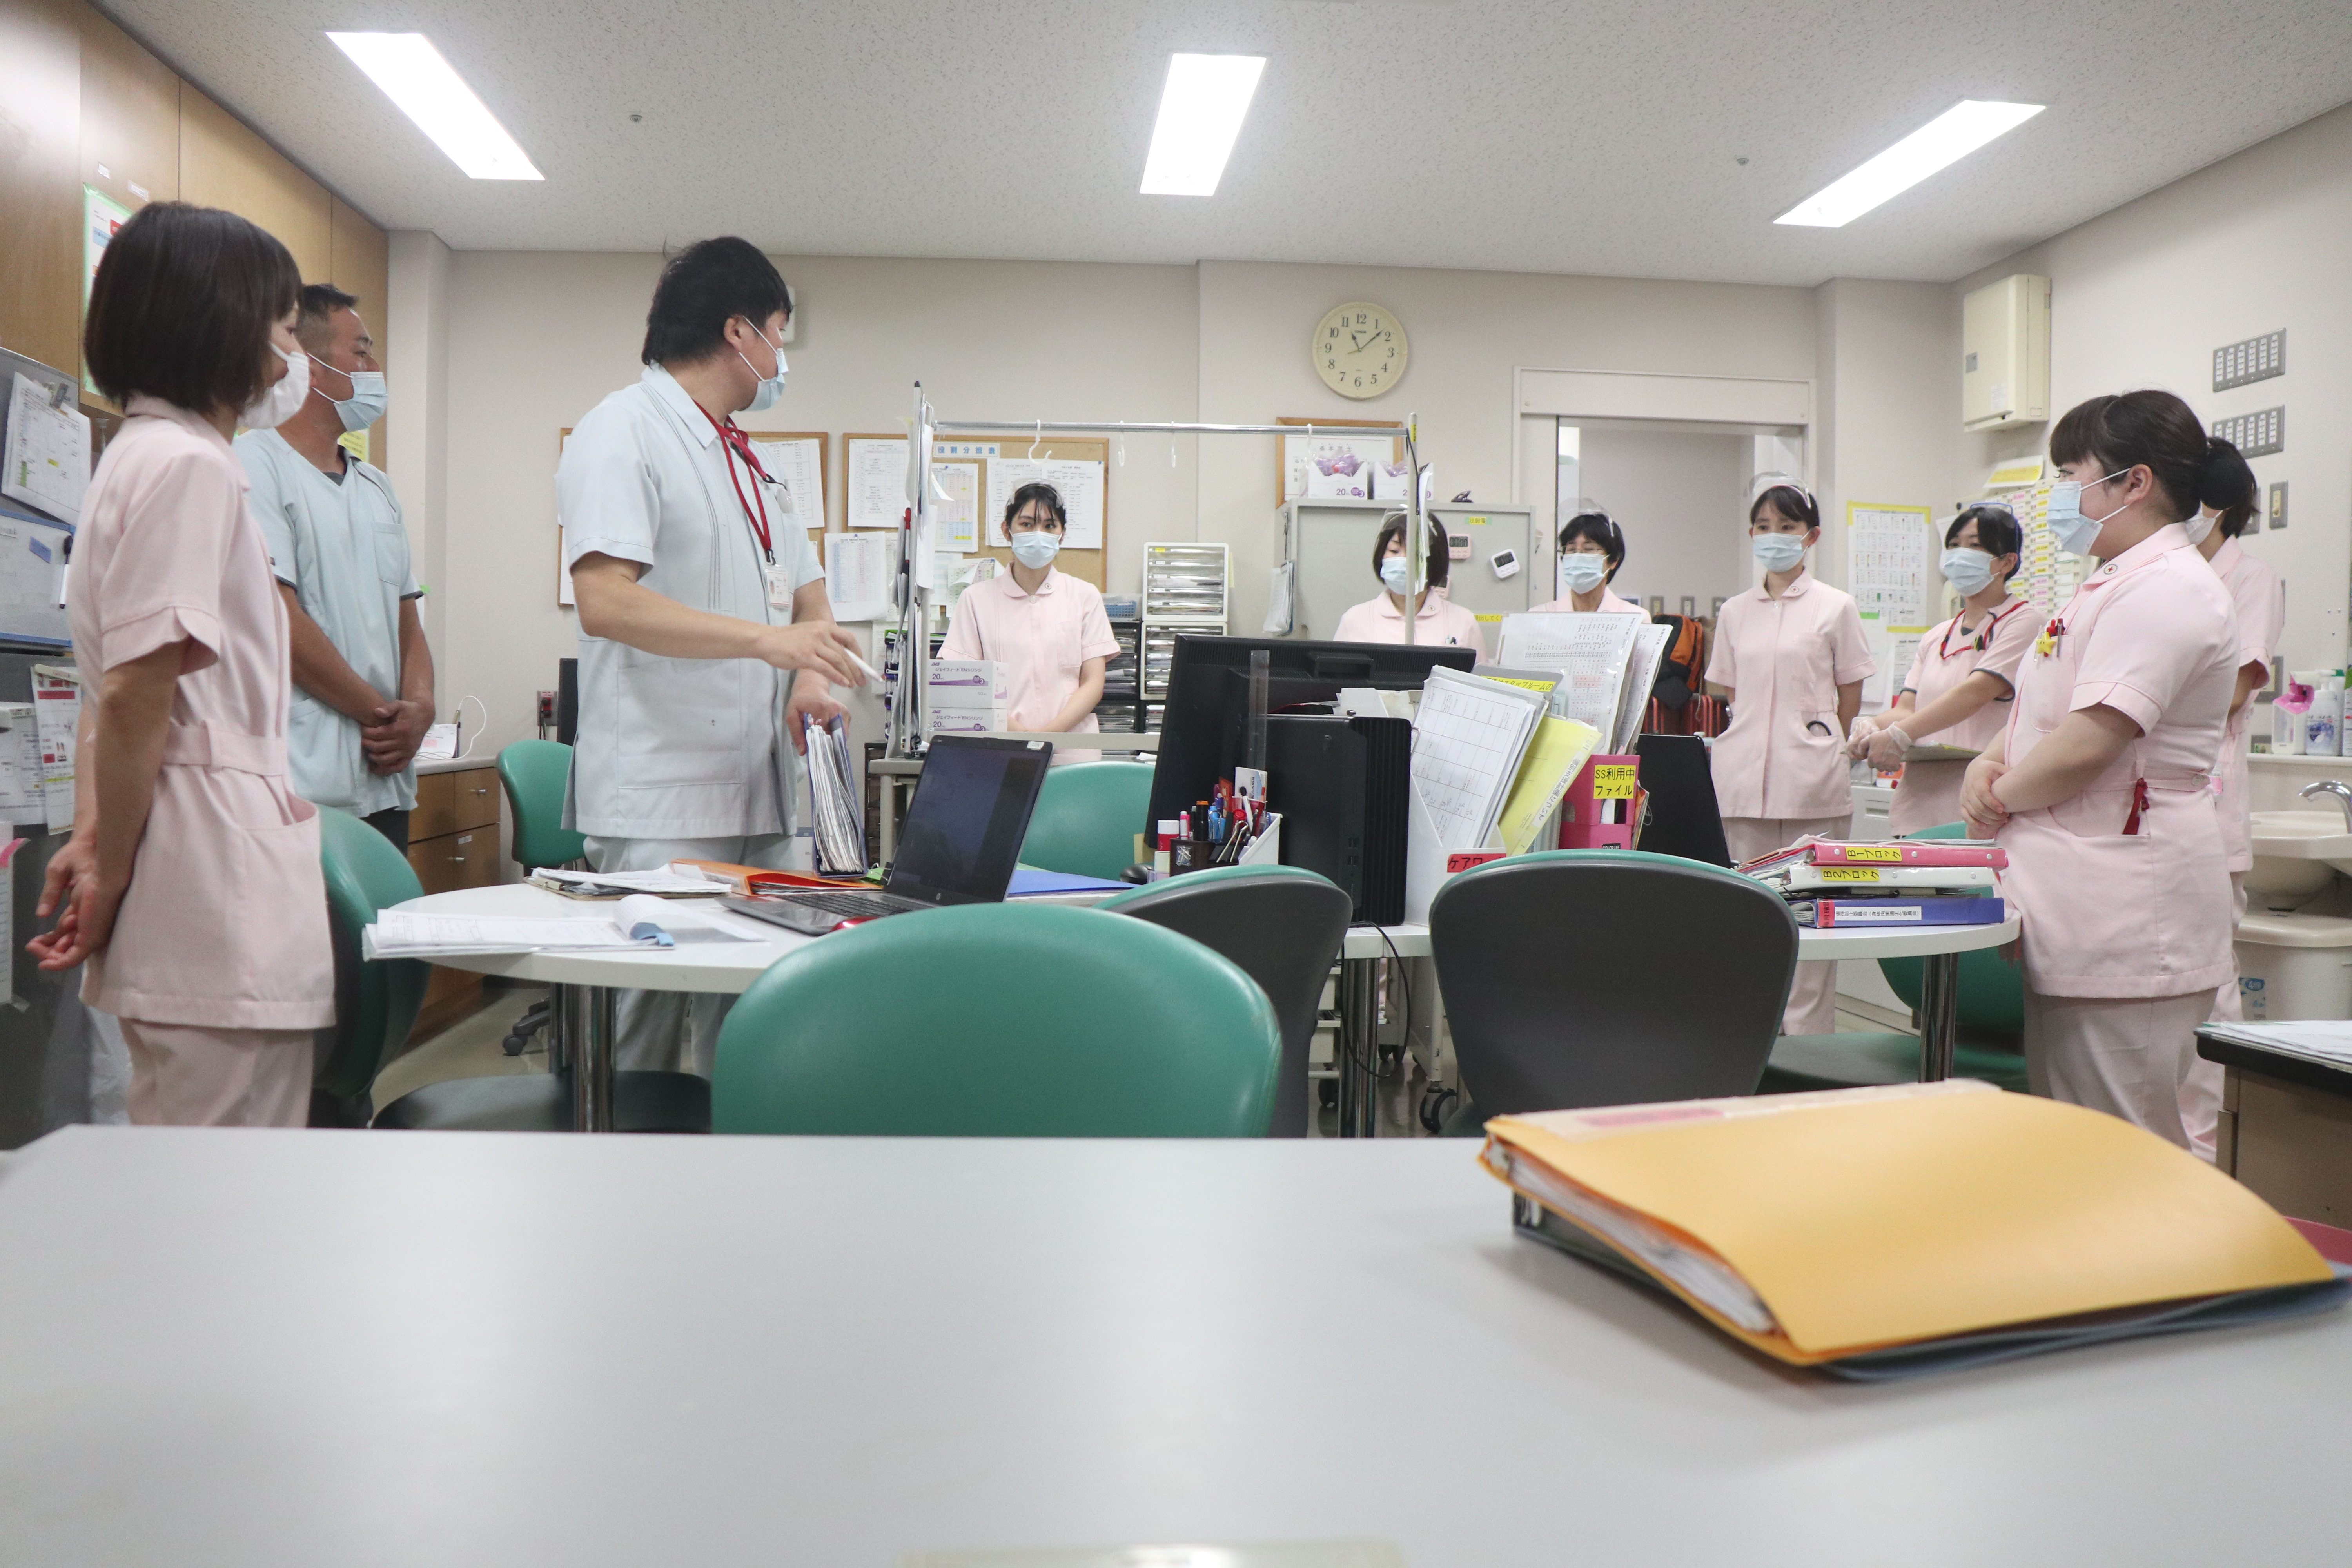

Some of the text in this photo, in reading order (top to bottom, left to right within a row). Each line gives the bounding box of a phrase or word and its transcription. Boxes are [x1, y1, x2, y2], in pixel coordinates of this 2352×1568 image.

[1341, 316, 1349, 327] 11
[1356, 314, 1367, 324] 12
[1375, 319, 1379, 329] 1
[1330, 327, 1339, 338] 10
[1385, 331, 1391, 341] 2
[1325, 343, 1332, 353] 9
[1387, 347, 1394, 357] 3
[1328, 359, 1335, 369] 8
[1381, 363, 1388, 372] 4
[1339, 372, 1346, 381] 7
[1355, 376, 1361, 387] 6
[1370, 374, 1377, 384] 5
[1595, 768, 1635, 780] SS利用中
[1596, 785, 1632, 796] ファイル
[1847, 849, 1901, 859] B1ブロック
[1823, 869, 1880, 879] B2ブロック
